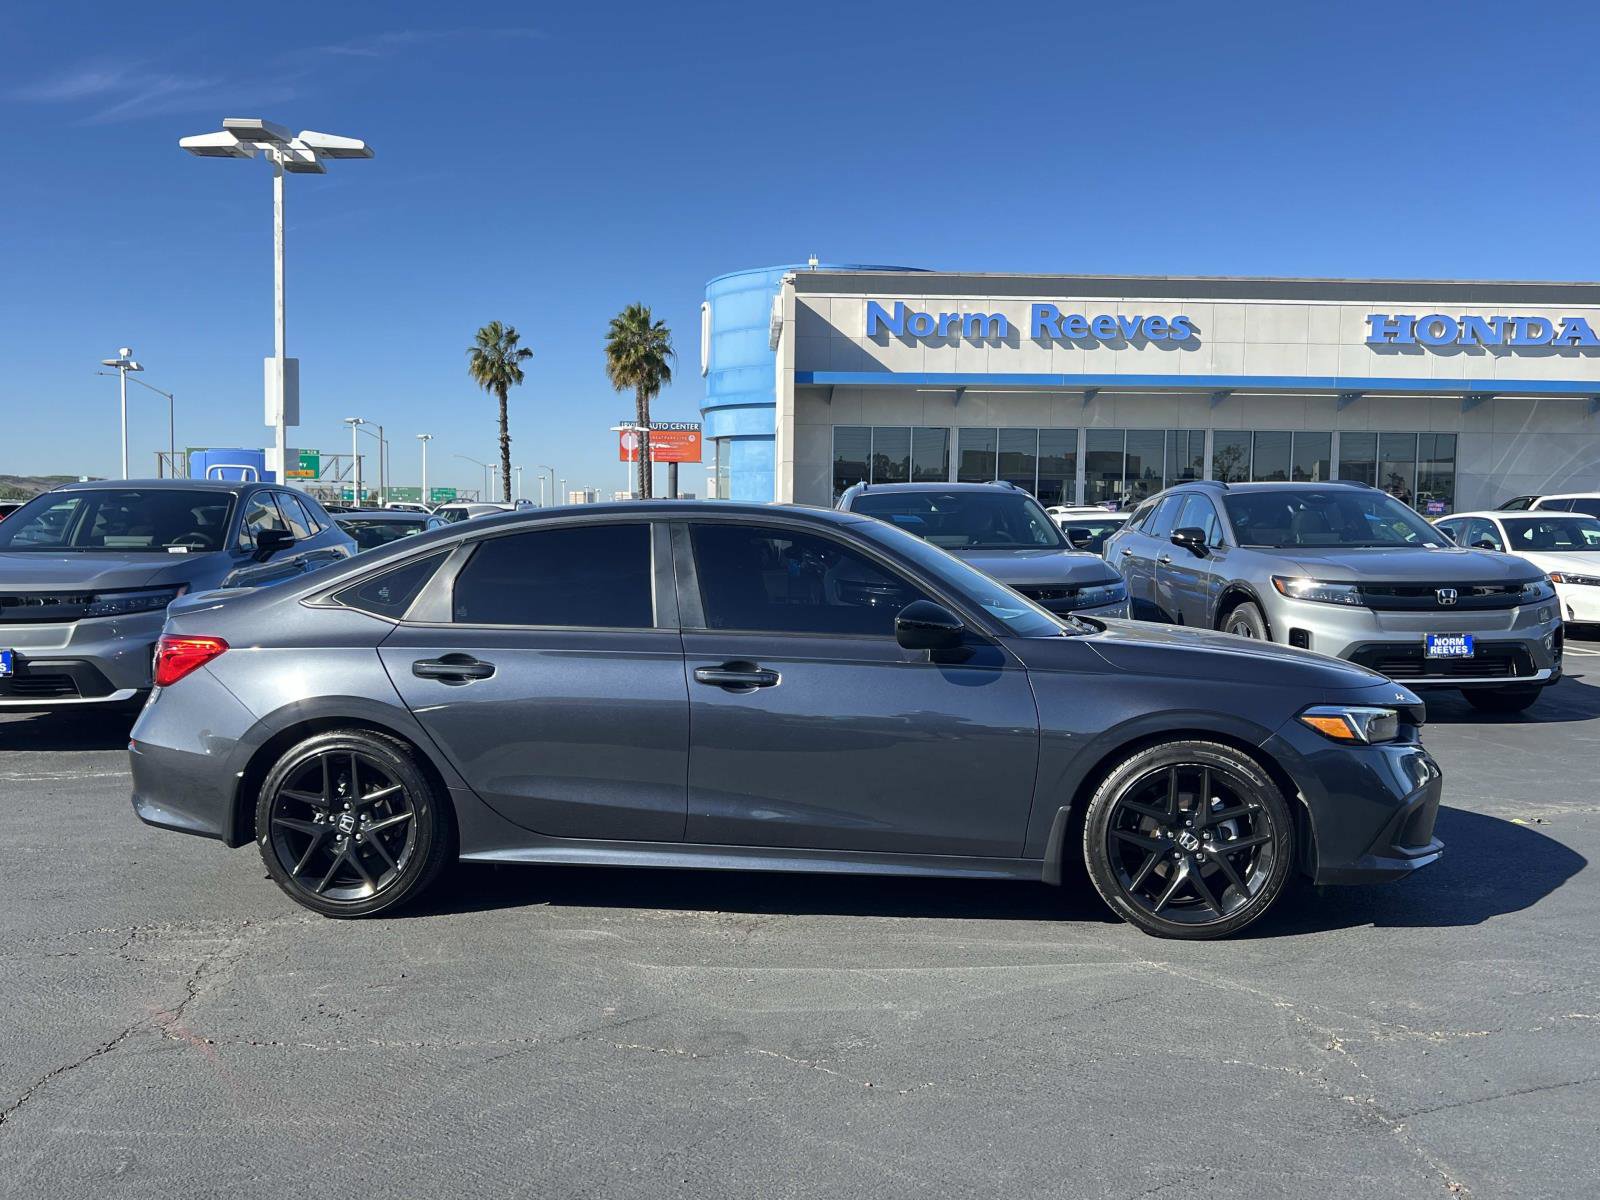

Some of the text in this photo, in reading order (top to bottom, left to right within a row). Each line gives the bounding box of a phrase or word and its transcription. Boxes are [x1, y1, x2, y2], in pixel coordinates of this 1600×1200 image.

[866, 301, 1192, 340] Norm Reeves
[1366, 314, 1600, 346] HONDA
[1430, 645, 1468, 654] REEVES
[1434, 637, 1465, 646] NORM
